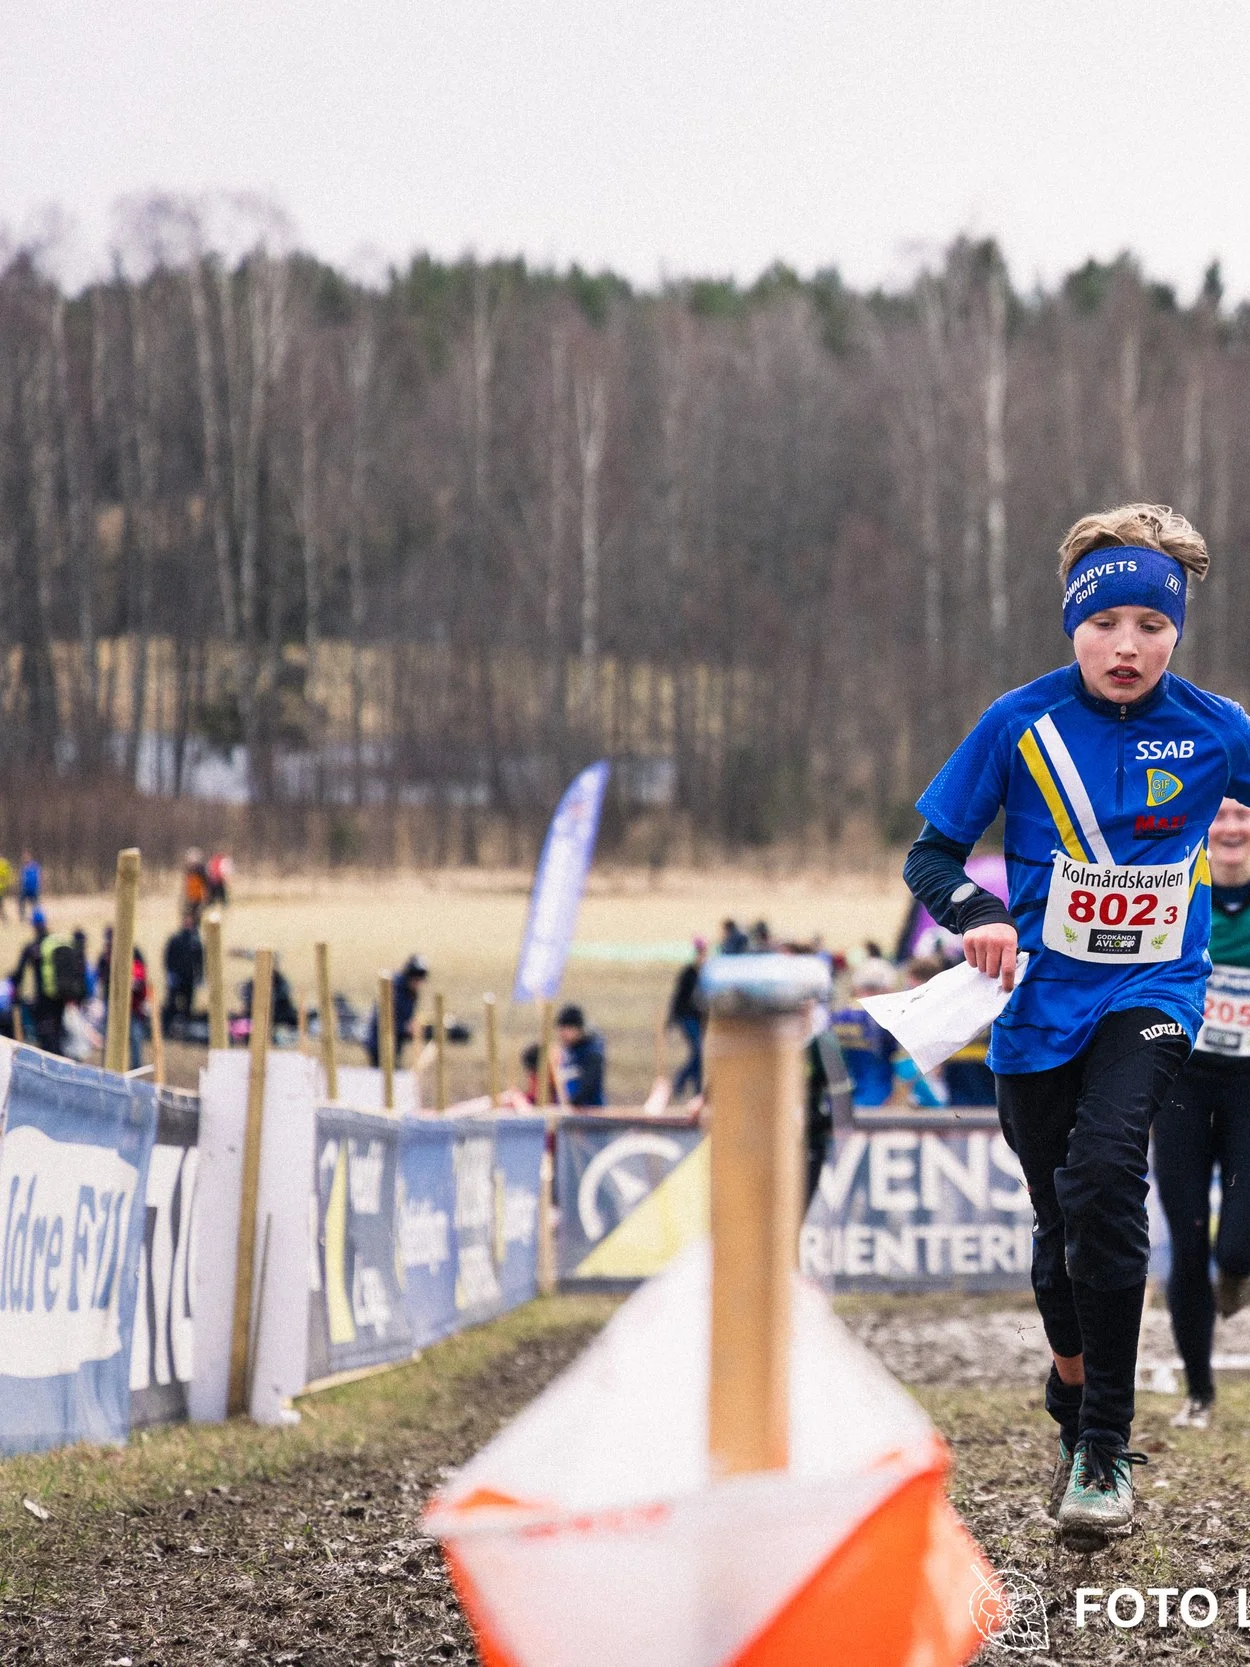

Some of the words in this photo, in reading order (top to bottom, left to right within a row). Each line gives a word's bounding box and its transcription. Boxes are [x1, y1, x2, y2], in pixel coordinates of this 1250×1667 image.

[1135, 740, 1195, 760] SSAB
[1152, 779, 1170, 790] GIF
[1062, 861, 1183, 889] Kolmårdskavlen
[1067, 890, 1158, 926] 802
[1163, 905, 1178, 925] 3
[1096, 933, 1136, 941] GODKÄNDA
